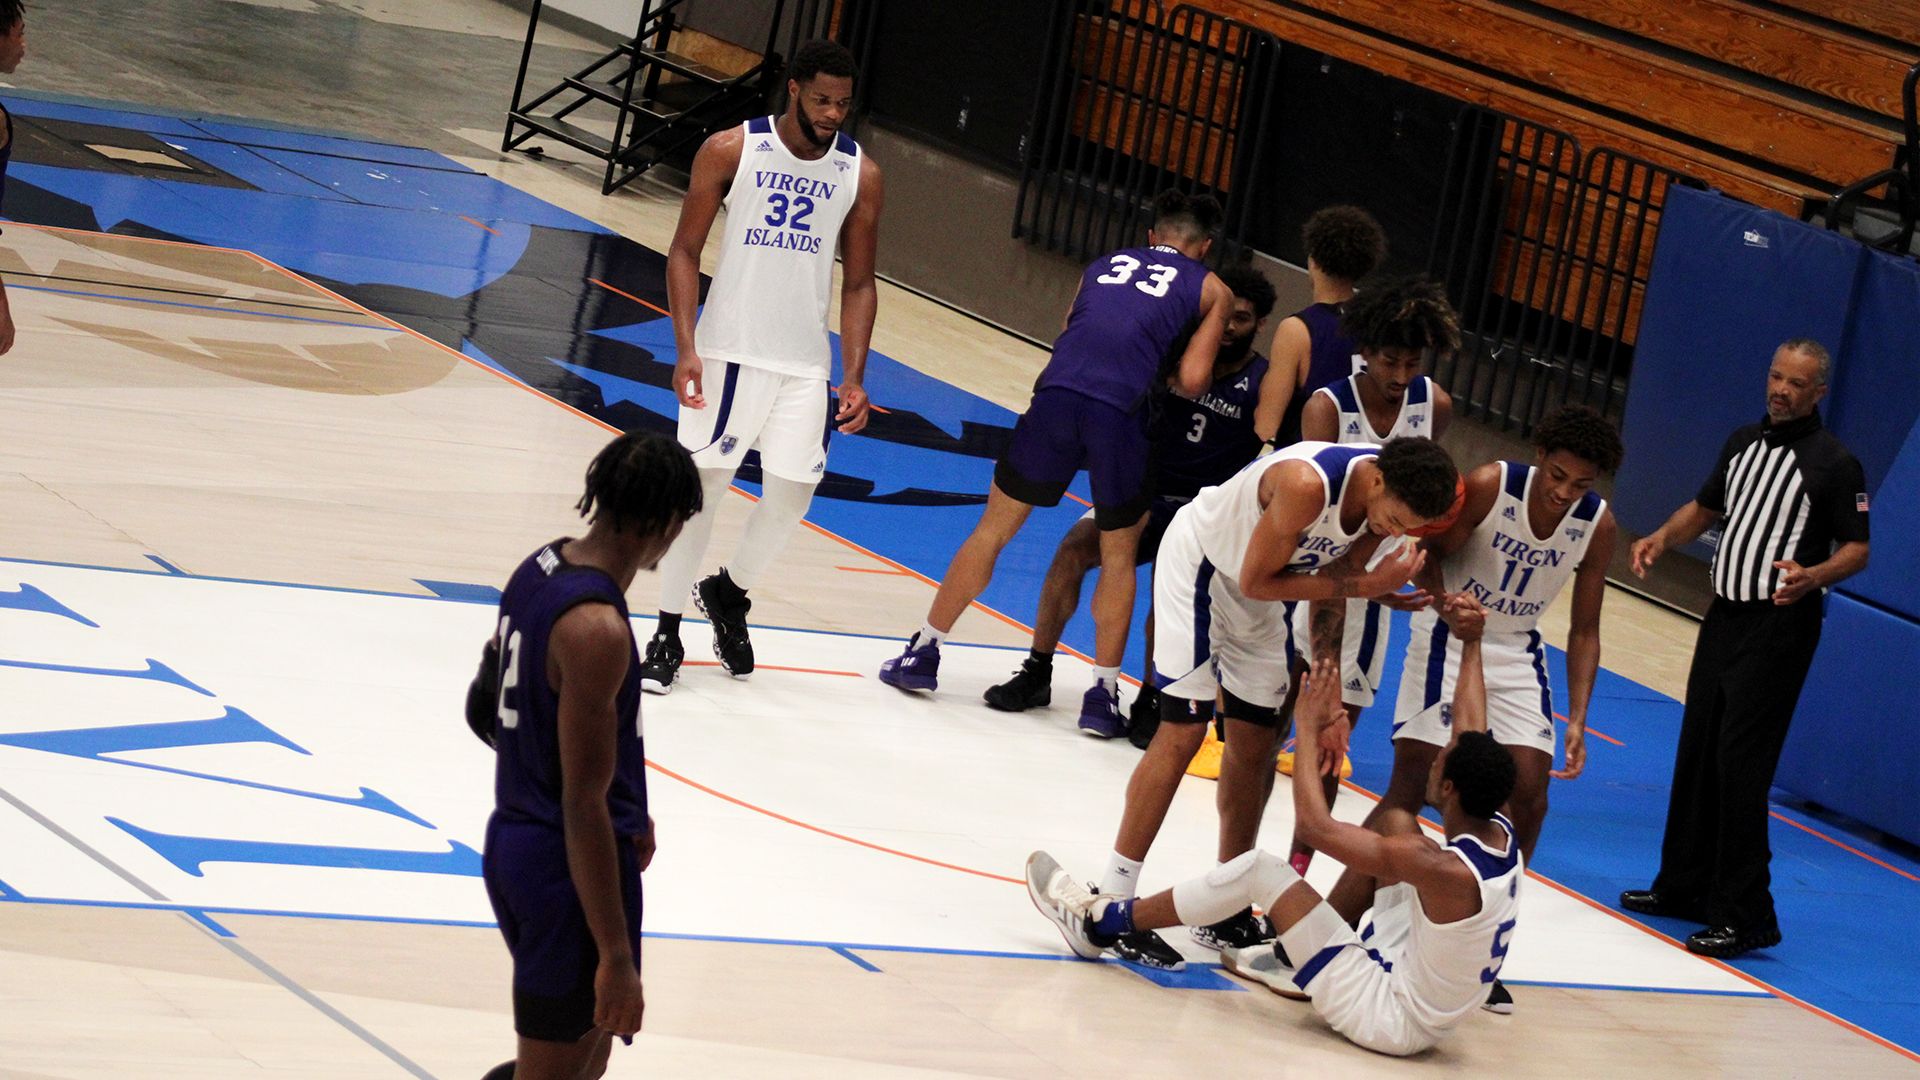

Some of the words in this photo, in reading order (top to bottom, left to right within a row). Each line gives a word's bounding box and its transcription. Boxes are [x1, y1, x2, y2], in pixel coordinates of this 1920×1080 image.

[755, 171, 837, 200] VIRGIN
[764, 193, 814, 231] 32
[743, 228, 821, 254] ISLANDS
[1097, 254, 1178, 297] 33
[1198, 393, 1241, 419] ALABAMA
[1186, 413, 1207, 442] 3
[1499, 560, 1534, 597] 11
[1461, 577, 1544, 616] ISLANDS
